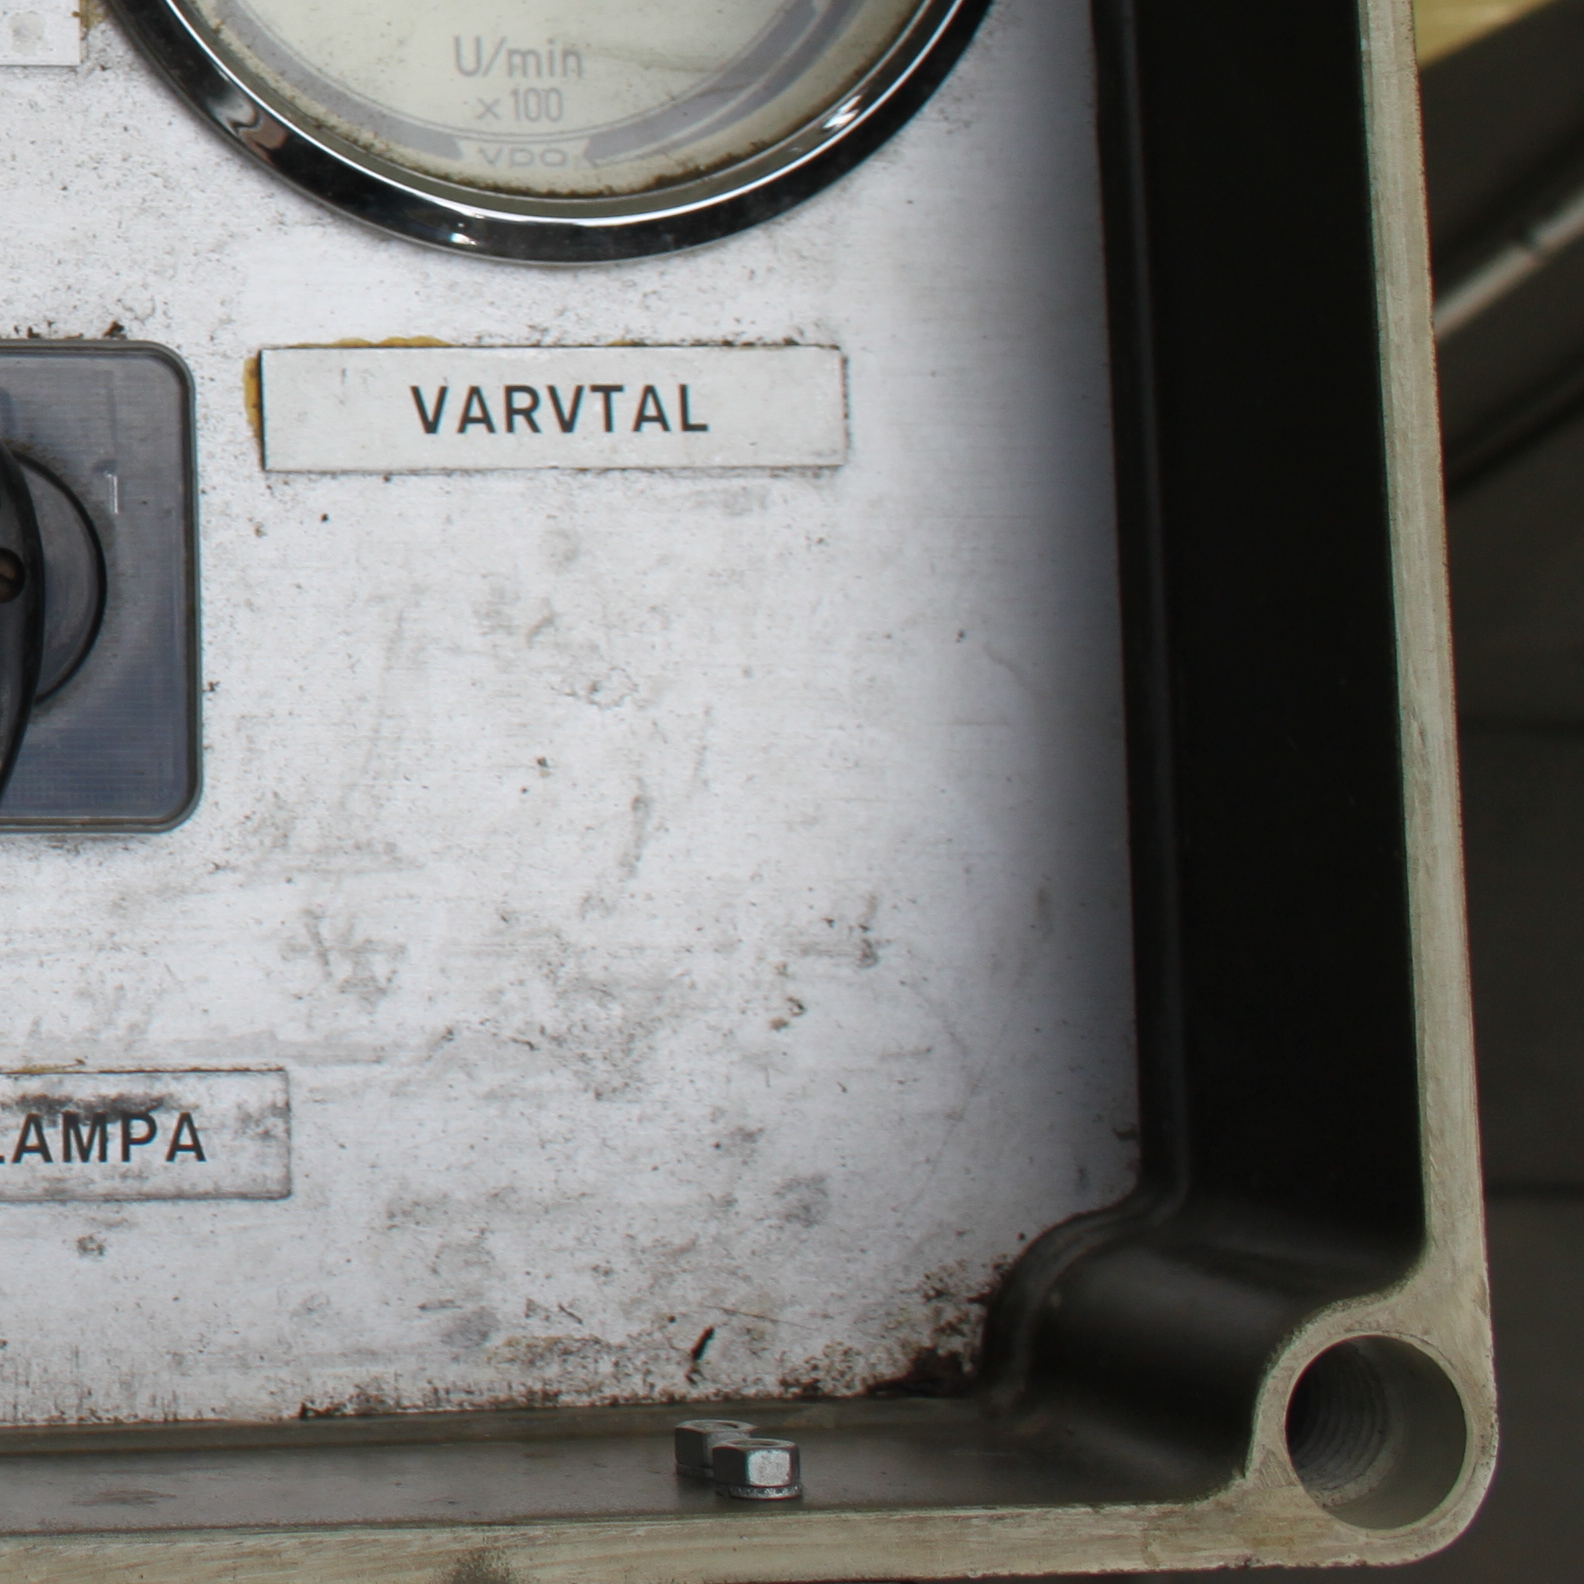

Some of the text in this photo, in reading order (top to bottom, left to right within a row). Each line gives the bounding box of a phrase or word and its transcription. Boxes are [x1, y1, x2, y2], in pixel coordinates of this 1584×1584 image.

[453, 35, 584, 77] U/min
[478, 147, 568, 167] VDO
[409, 382, 710, 435] VARVTAL
